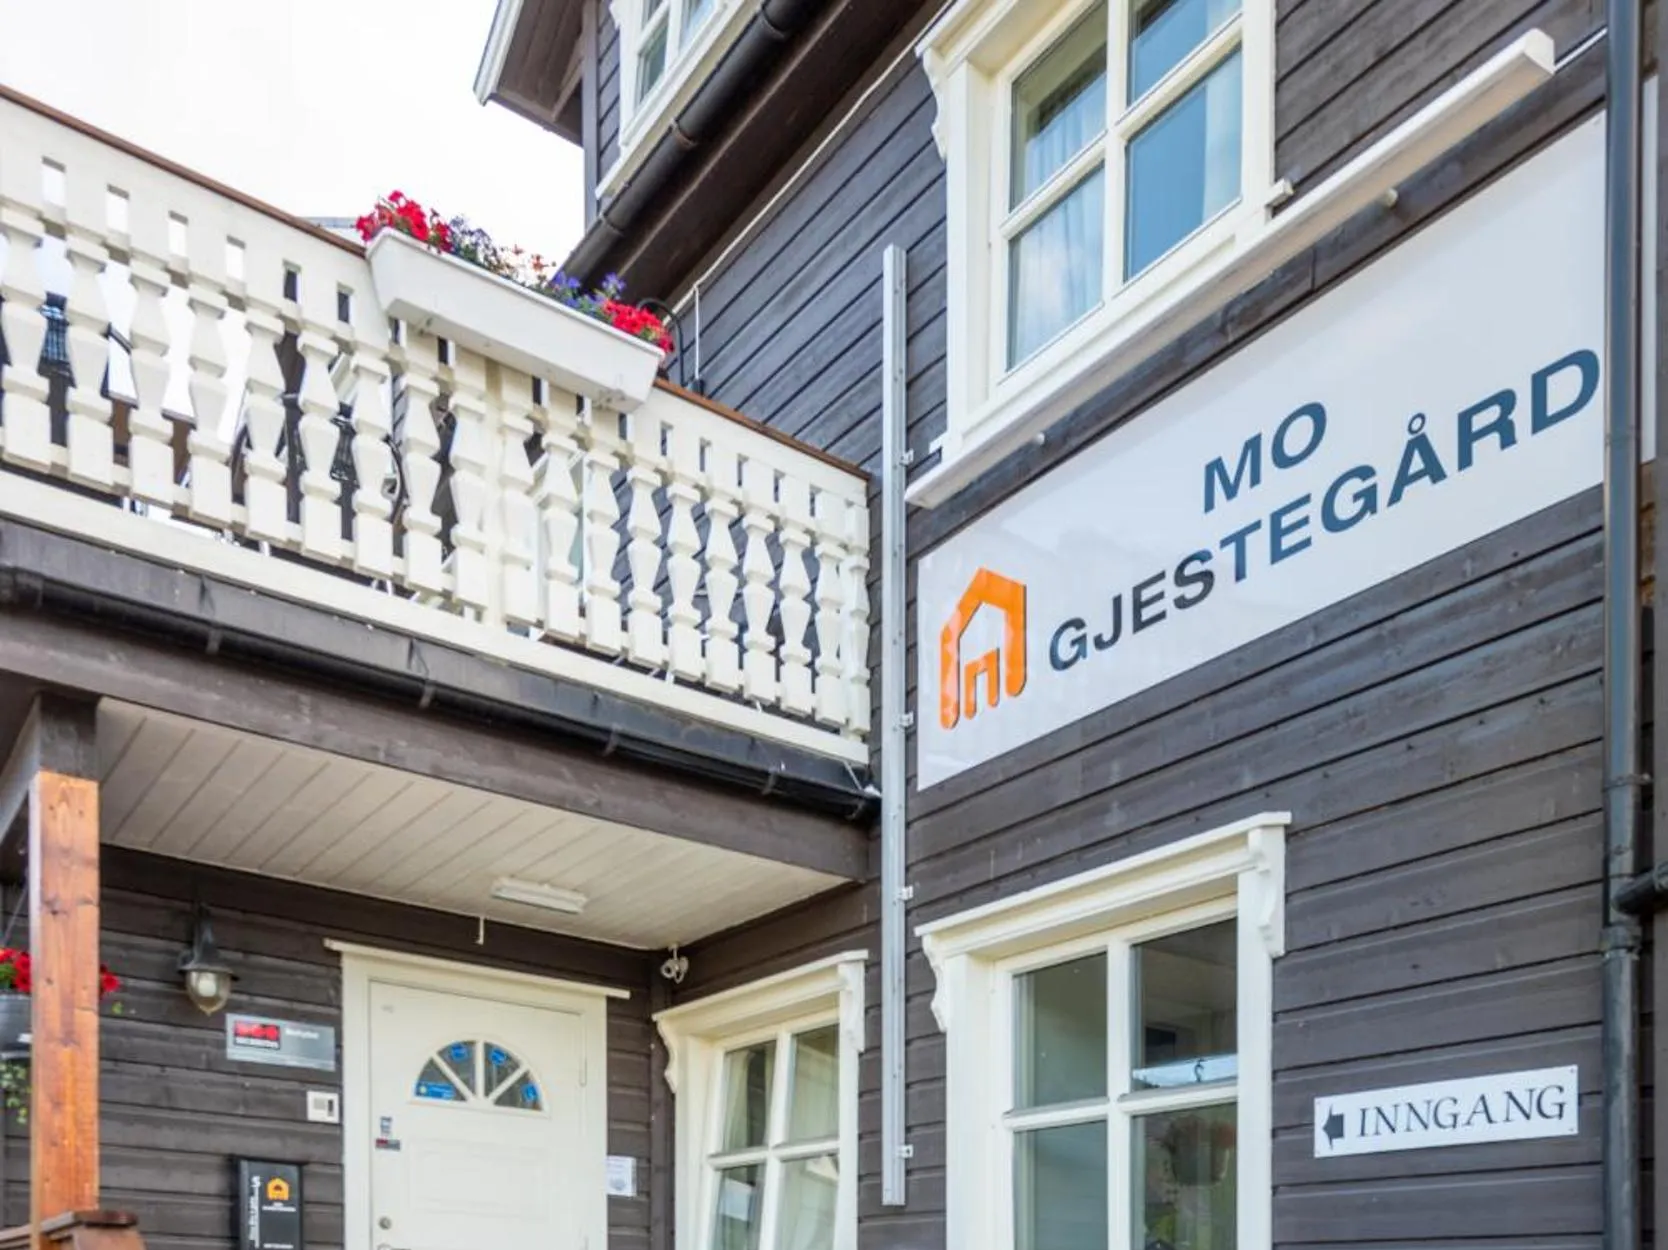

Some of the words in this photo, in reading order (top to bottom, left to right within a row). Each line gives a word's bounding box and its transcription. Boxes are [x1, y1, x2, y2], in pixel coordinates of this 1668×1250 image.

[1048, 348, 1601, 673] GJESTEGÅRD
[1204, 401, 1328, 514] MO
[1356, 1083, 1567, 1138] INNGANG
